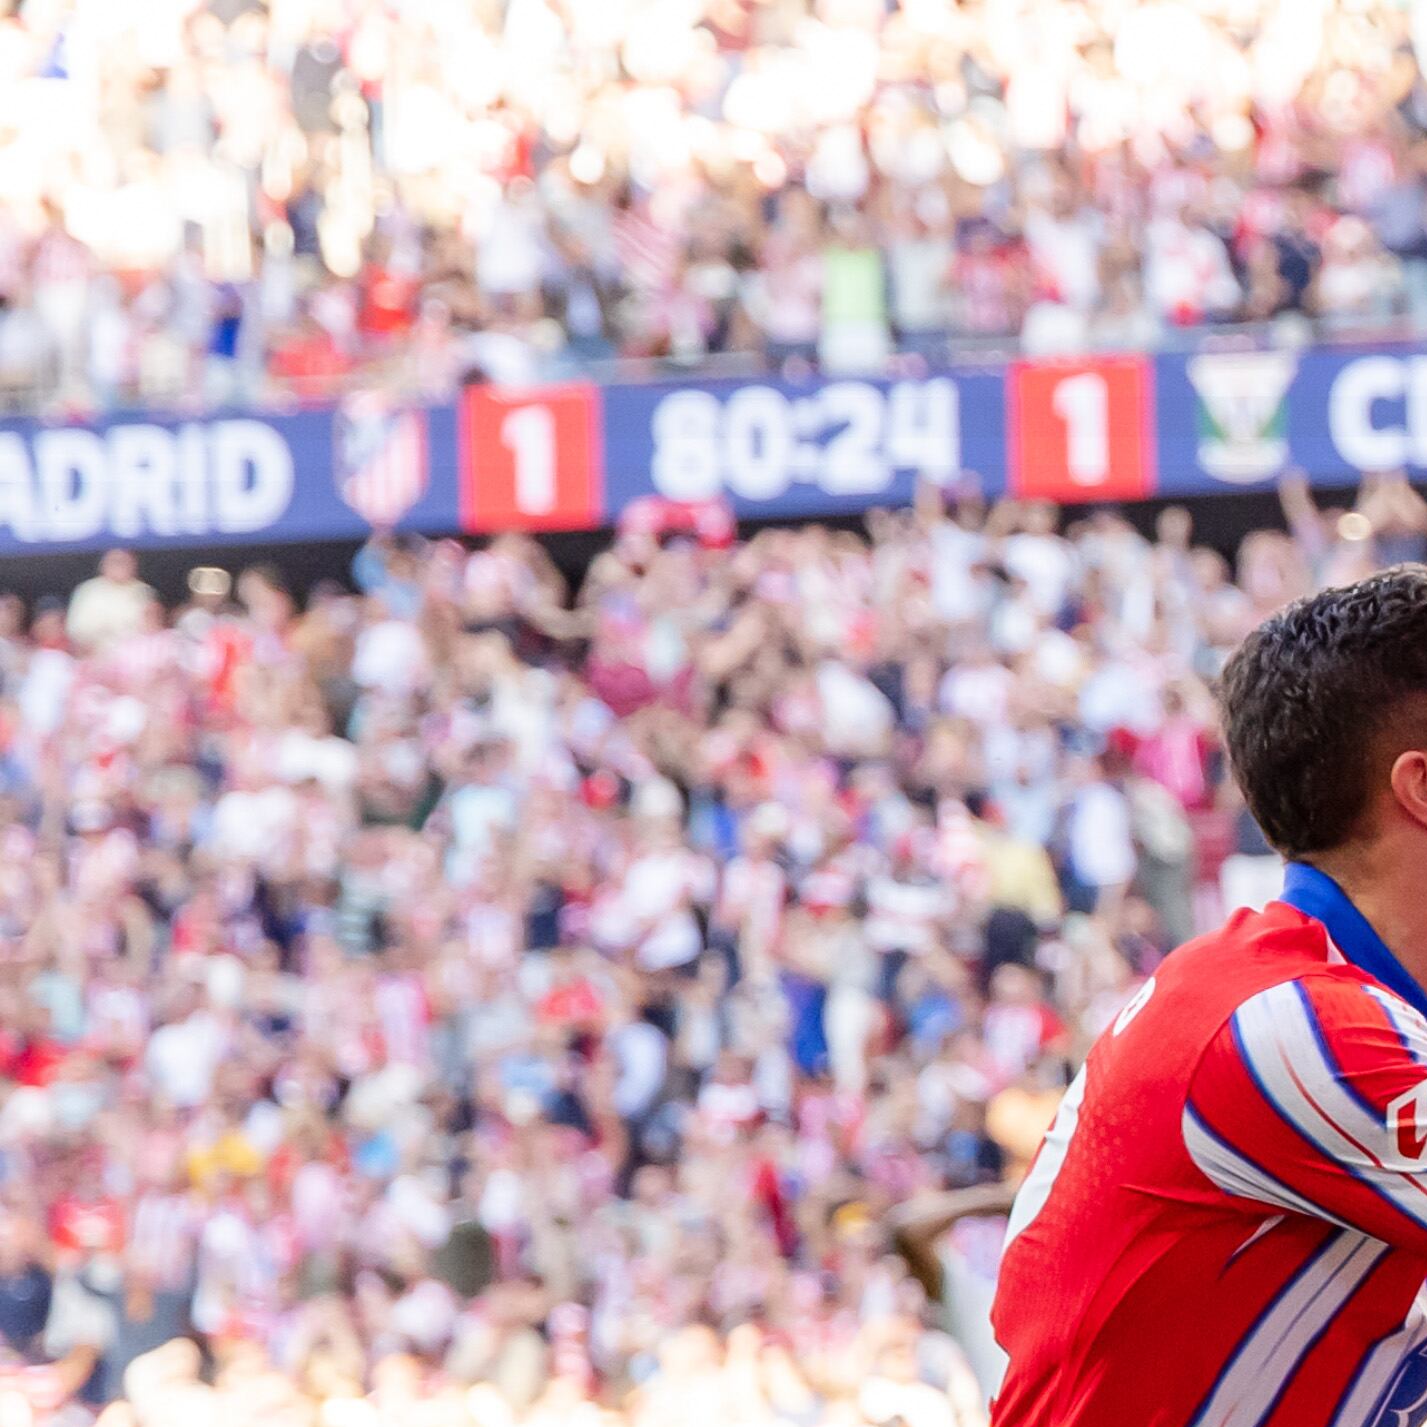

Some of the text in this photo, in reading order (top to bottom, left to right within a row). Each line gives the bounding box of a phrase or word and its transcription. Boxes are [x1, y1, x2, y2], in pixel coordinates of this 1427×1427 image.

[502, 402, 556, 516] 1
[650, 377, 960, 500] 80:24
[1052, 372, 1111, 487] 1
